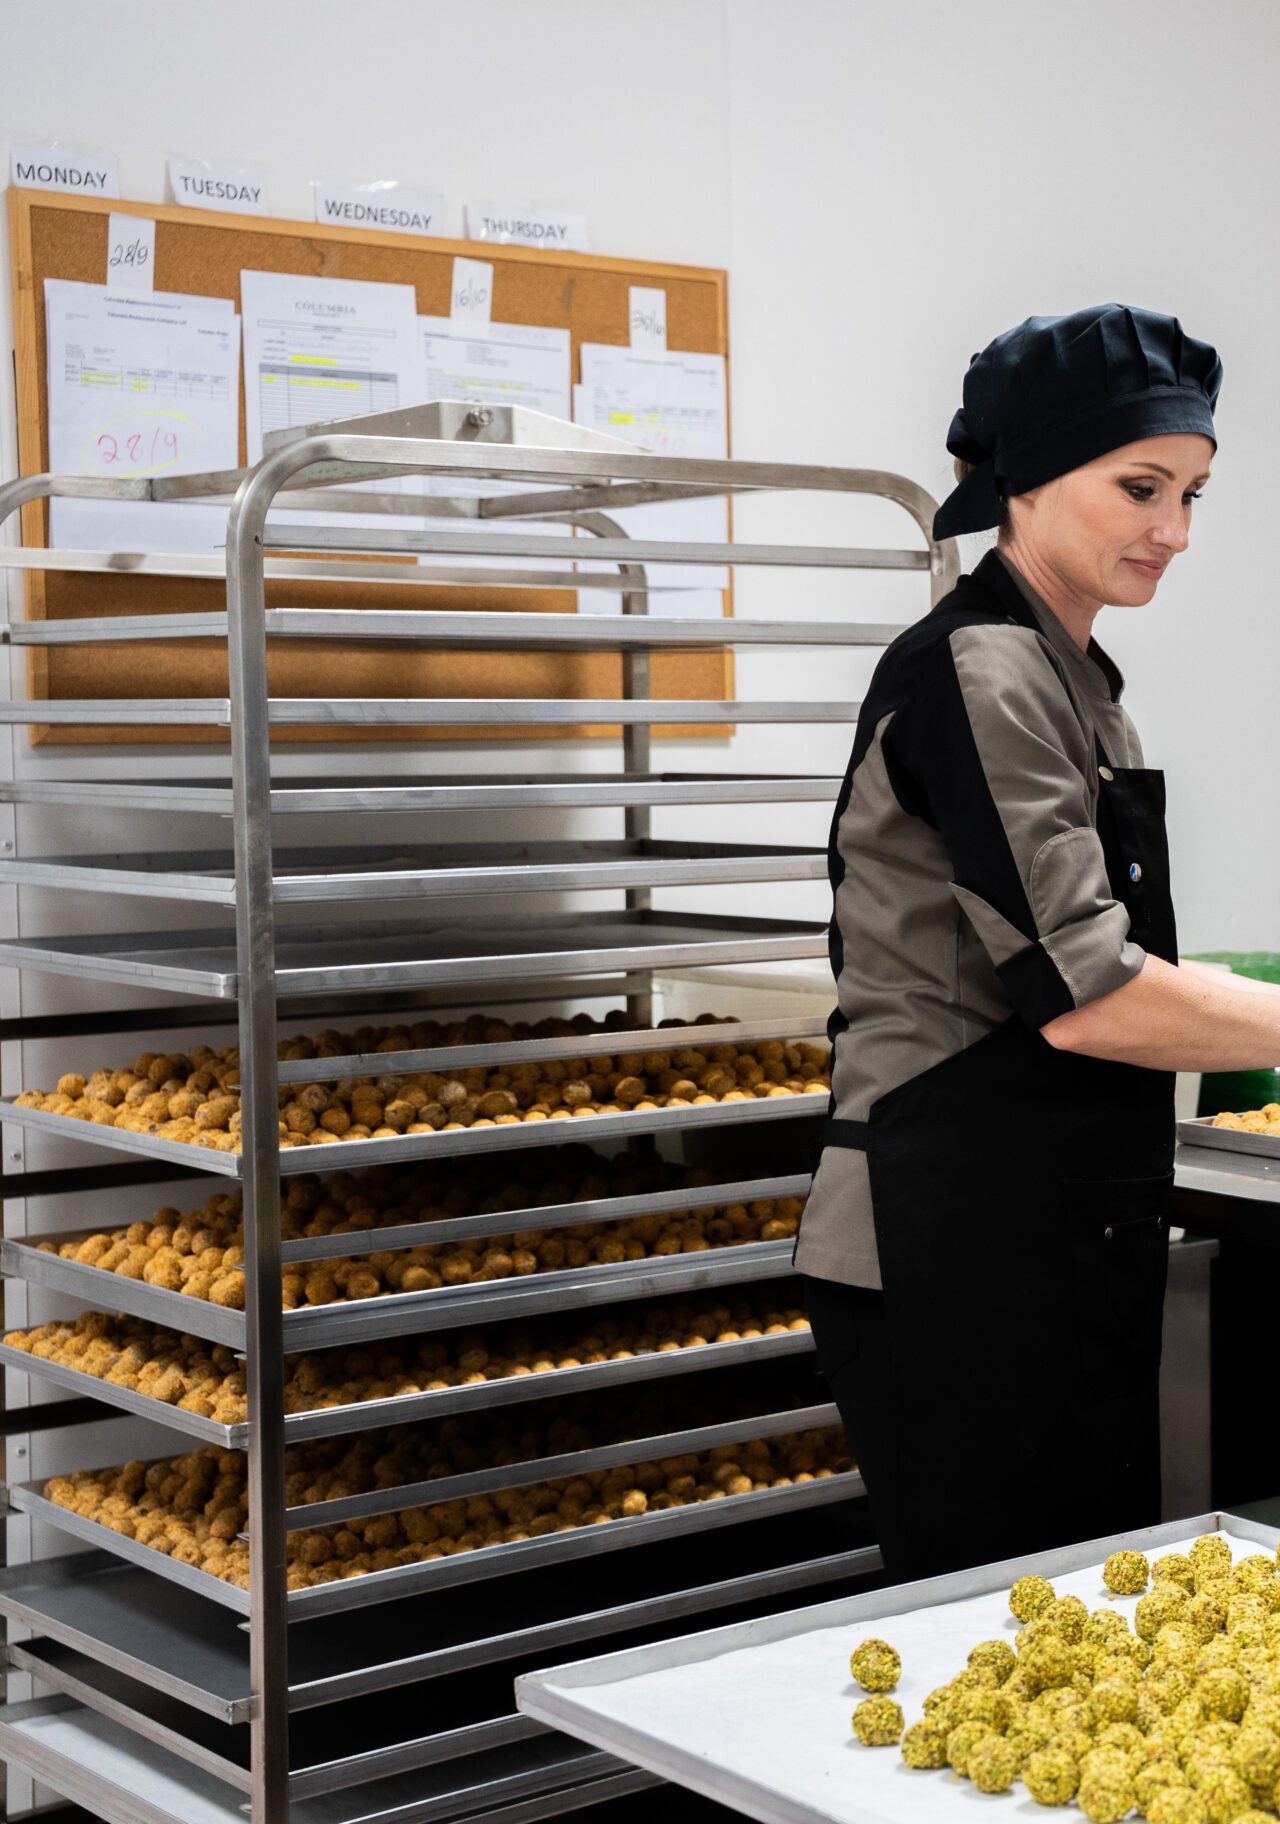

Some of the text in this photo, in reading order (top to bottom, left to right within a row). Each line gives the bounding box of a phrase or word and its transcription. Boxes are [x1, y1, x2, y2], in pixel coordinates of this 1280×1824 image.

[16, 162, 108, 189] MONDAY
[179, 175, 261, 204] TUESDAY
[323, 198, 433, 230] WEDNESDAY
[482, 216, 569, 240] THURSDAY
[109, 238, 149, 267] 28/9
[294, 300, 357, 315] COLUMBIA
[98, 426, 179, 466] 28/9
